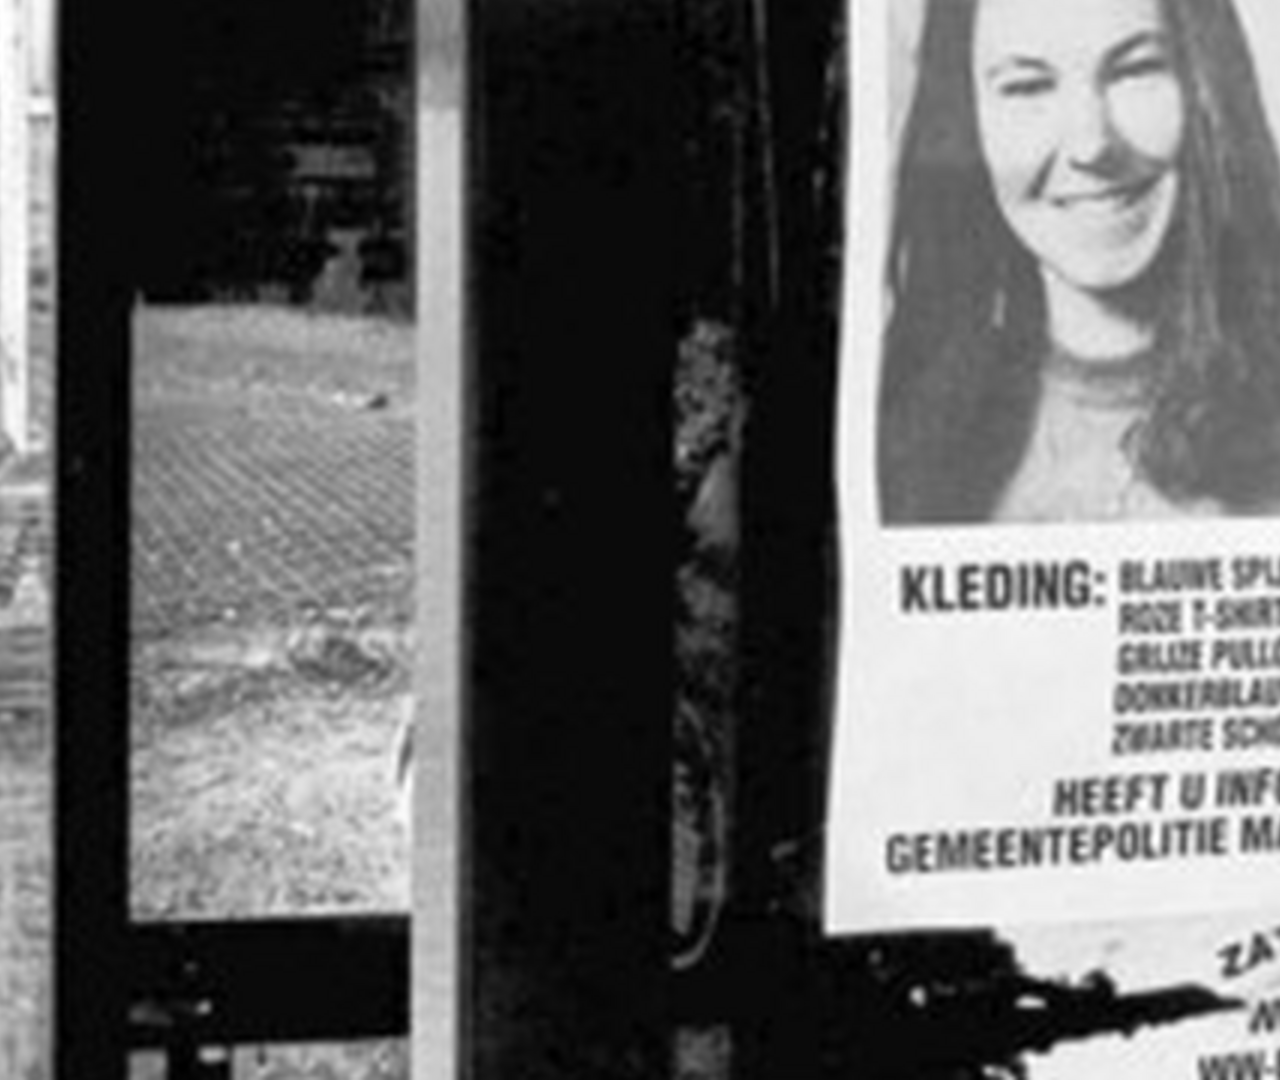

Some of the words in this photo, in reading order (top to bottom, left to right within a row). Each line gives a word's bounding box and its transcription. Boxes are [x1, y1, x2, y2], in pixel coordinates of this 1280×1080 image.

[900, 560, 1106, 614] KLEDING:
[1118, 556, 1223, 594] BLAUWE
[1113, 718, 1212, 756] ZWARTE
[1053, 773, 1169, 818] HEEFT
[1180, 772, 1205, 810] U
[886, 818, 1227, 874] GEMEENTEPOLITIE
